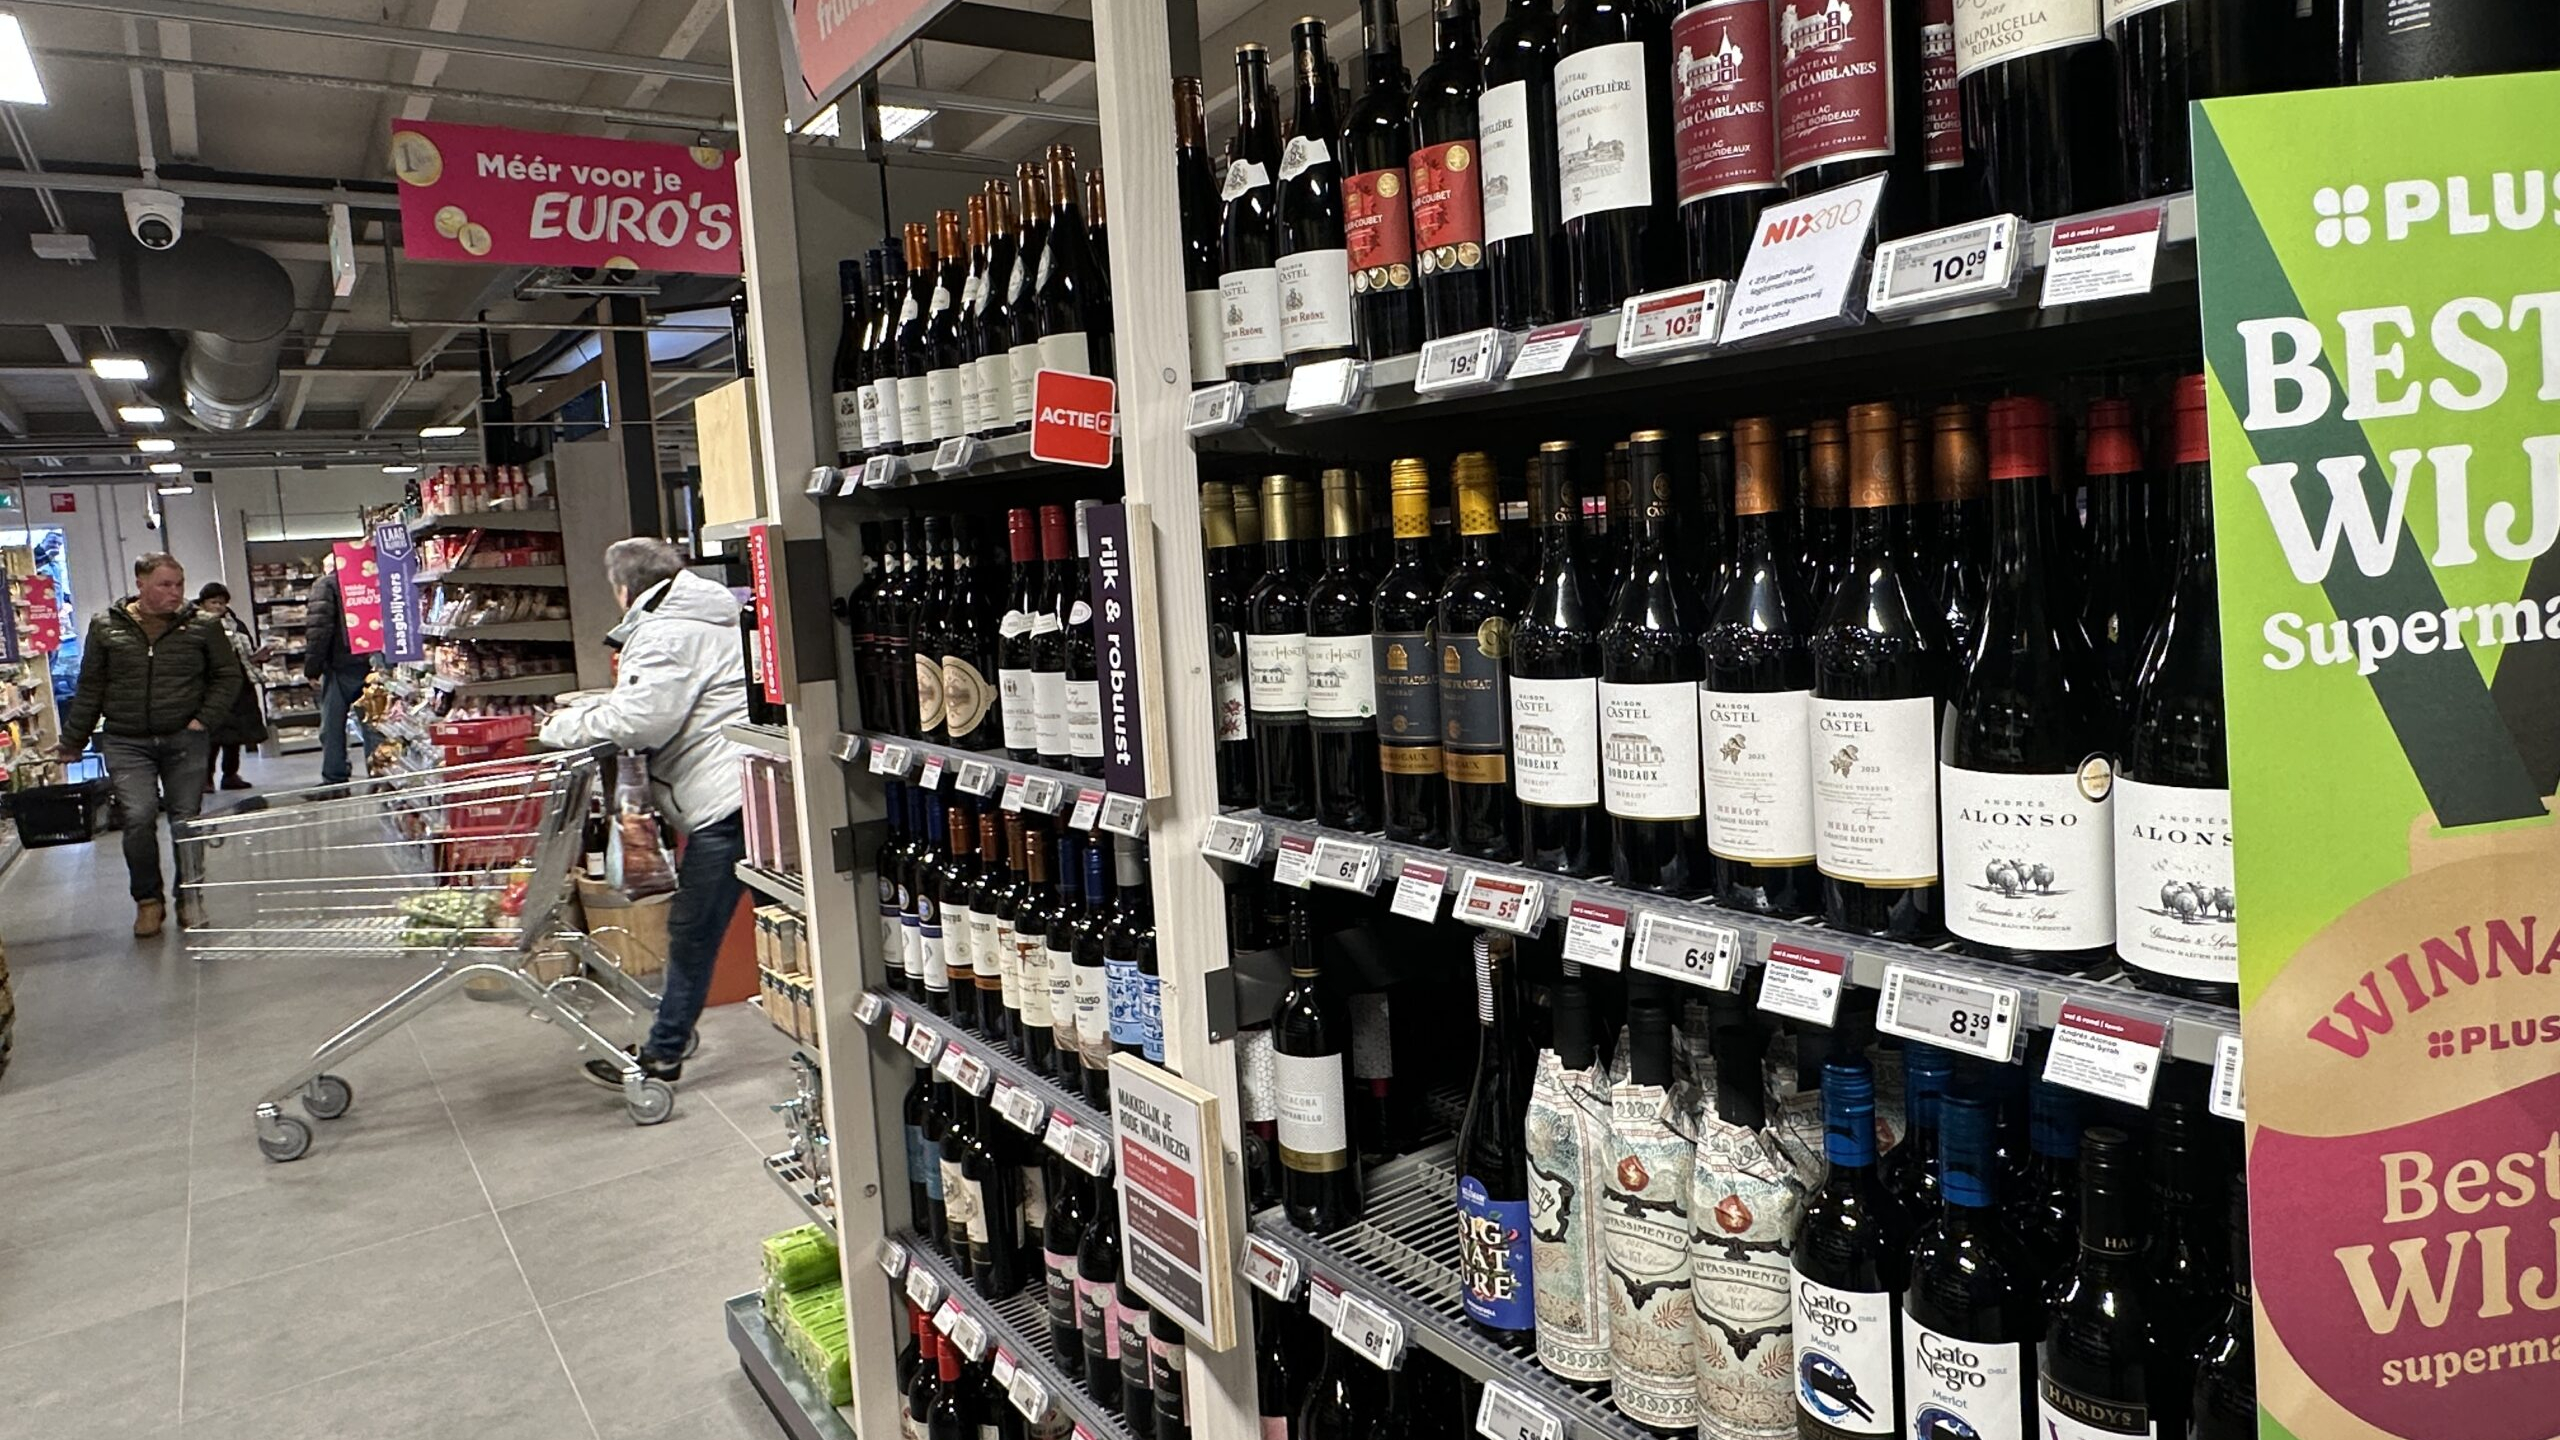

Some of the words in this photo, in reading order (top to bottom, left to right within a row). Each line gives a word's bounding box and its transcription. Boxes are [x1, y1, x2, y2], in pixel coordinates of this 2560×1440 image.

[1971, 30, 2024, 57] RIPASSO
[1786, 56, 1838, 78] CHATEAU
[1798, 62, 1877, 88] CAMBLANES
[1573, 79, 1632, 102] GAFFELIÈRE
[1683, 94, 1730, 114] CHATEAU
[1694, 101, 1765, 124] CAMBLANES
[1808, 108, 1861, 126] BORDEAUX
[1703, 144, 1752, 160] BORDEAUX
[477, 153, 562, 183] Méér
[571, 165, 645, 189] voor
[653, 166, 682, 196] je
[2384, 169, 2560, 242] PLU
[530, 191, 734, 251] EURO'S
[1761, 199, 1863, 247] NIX18
[1932, 249, 1987, 283] 10.09
[1450, 351, 1479, 376] 19.49
[2236, 291, 2560, 431] BEST
[1039, 406, 1096, 429] ACTIE
[2246, 434, 2560, 584] WIJ
[1099, 536, 1120, 589] rijk
[390, 572, 408, 656] Laagblijvers
[1104, 598, 1122, 623] &
[1107, 633, 1131, 767] robuust
[1515, 699, 1553, 713] CASTEL
[1715, 702, 1751, 710] MAISON
[1606, 706, 1651, 720] CASTEL
[1709, 708, 1761, 723] CASTEL
[1819, 717, 1874, 733] CASTEL
[1825, 711, 1863, 719] MAISON
[1517, 756, 1559, 771] BORDEAUX
[1608, 766, 1658, 781] BORDEAUX
[1716, 805, 1761, 817] MERLOT
[1959, 807, 2079, 828] ALONSO
[1827, 820, 1876, 833] MERLOT
[2131, 823, 2233, 846] ALONS
[1685, 947, 1715, 971] 6.49
[1949, 1009, 1991, 1037] 8.39
[2461, 1014, 2560, 1054] PLUS
[1162, 1112, 1173, 1132] JE
[2380, 1130, 2560, 1223] Best
[1696, 1261, 1788, 1286] APPASSIMENTO
[2334, 1217, 2560, 1335] WIJ
[1800, 1281, 1851, 1316] Gato
[1798, 1295, 1858, 1337] Negro
[1810, 1333, 1841, 1353] Merlot
[1919, 1331, 1979, 1368] Gato
[1916, 1346, 1987, 1392] Negro
[1932, 1388, 1968, 1409] Merlot
[2048, 1384, 2132, 1426] HARDYS
